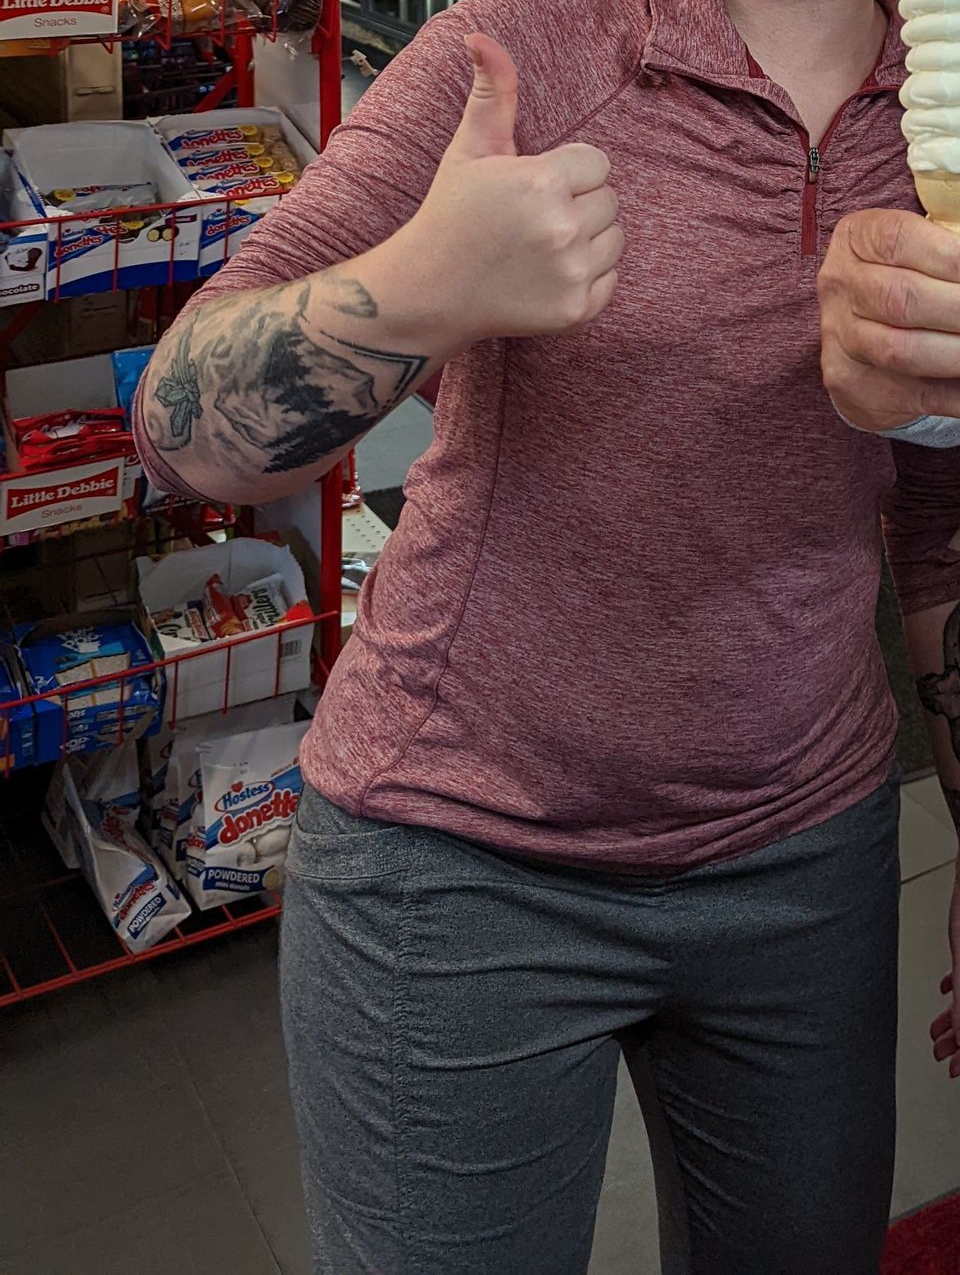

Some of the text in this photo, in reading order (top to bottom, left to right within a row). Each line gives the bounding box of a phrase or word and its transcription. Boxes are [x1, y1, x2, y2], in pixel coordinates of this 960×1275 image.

[34, 18, 77, 27] Snacks
[10, 478, 114, 509] Little Debbie
[41, 504, 82, 518] Snacks
[222, 783, 270, 810] Hostess
[208, 869, 260, 884] POWDERED
